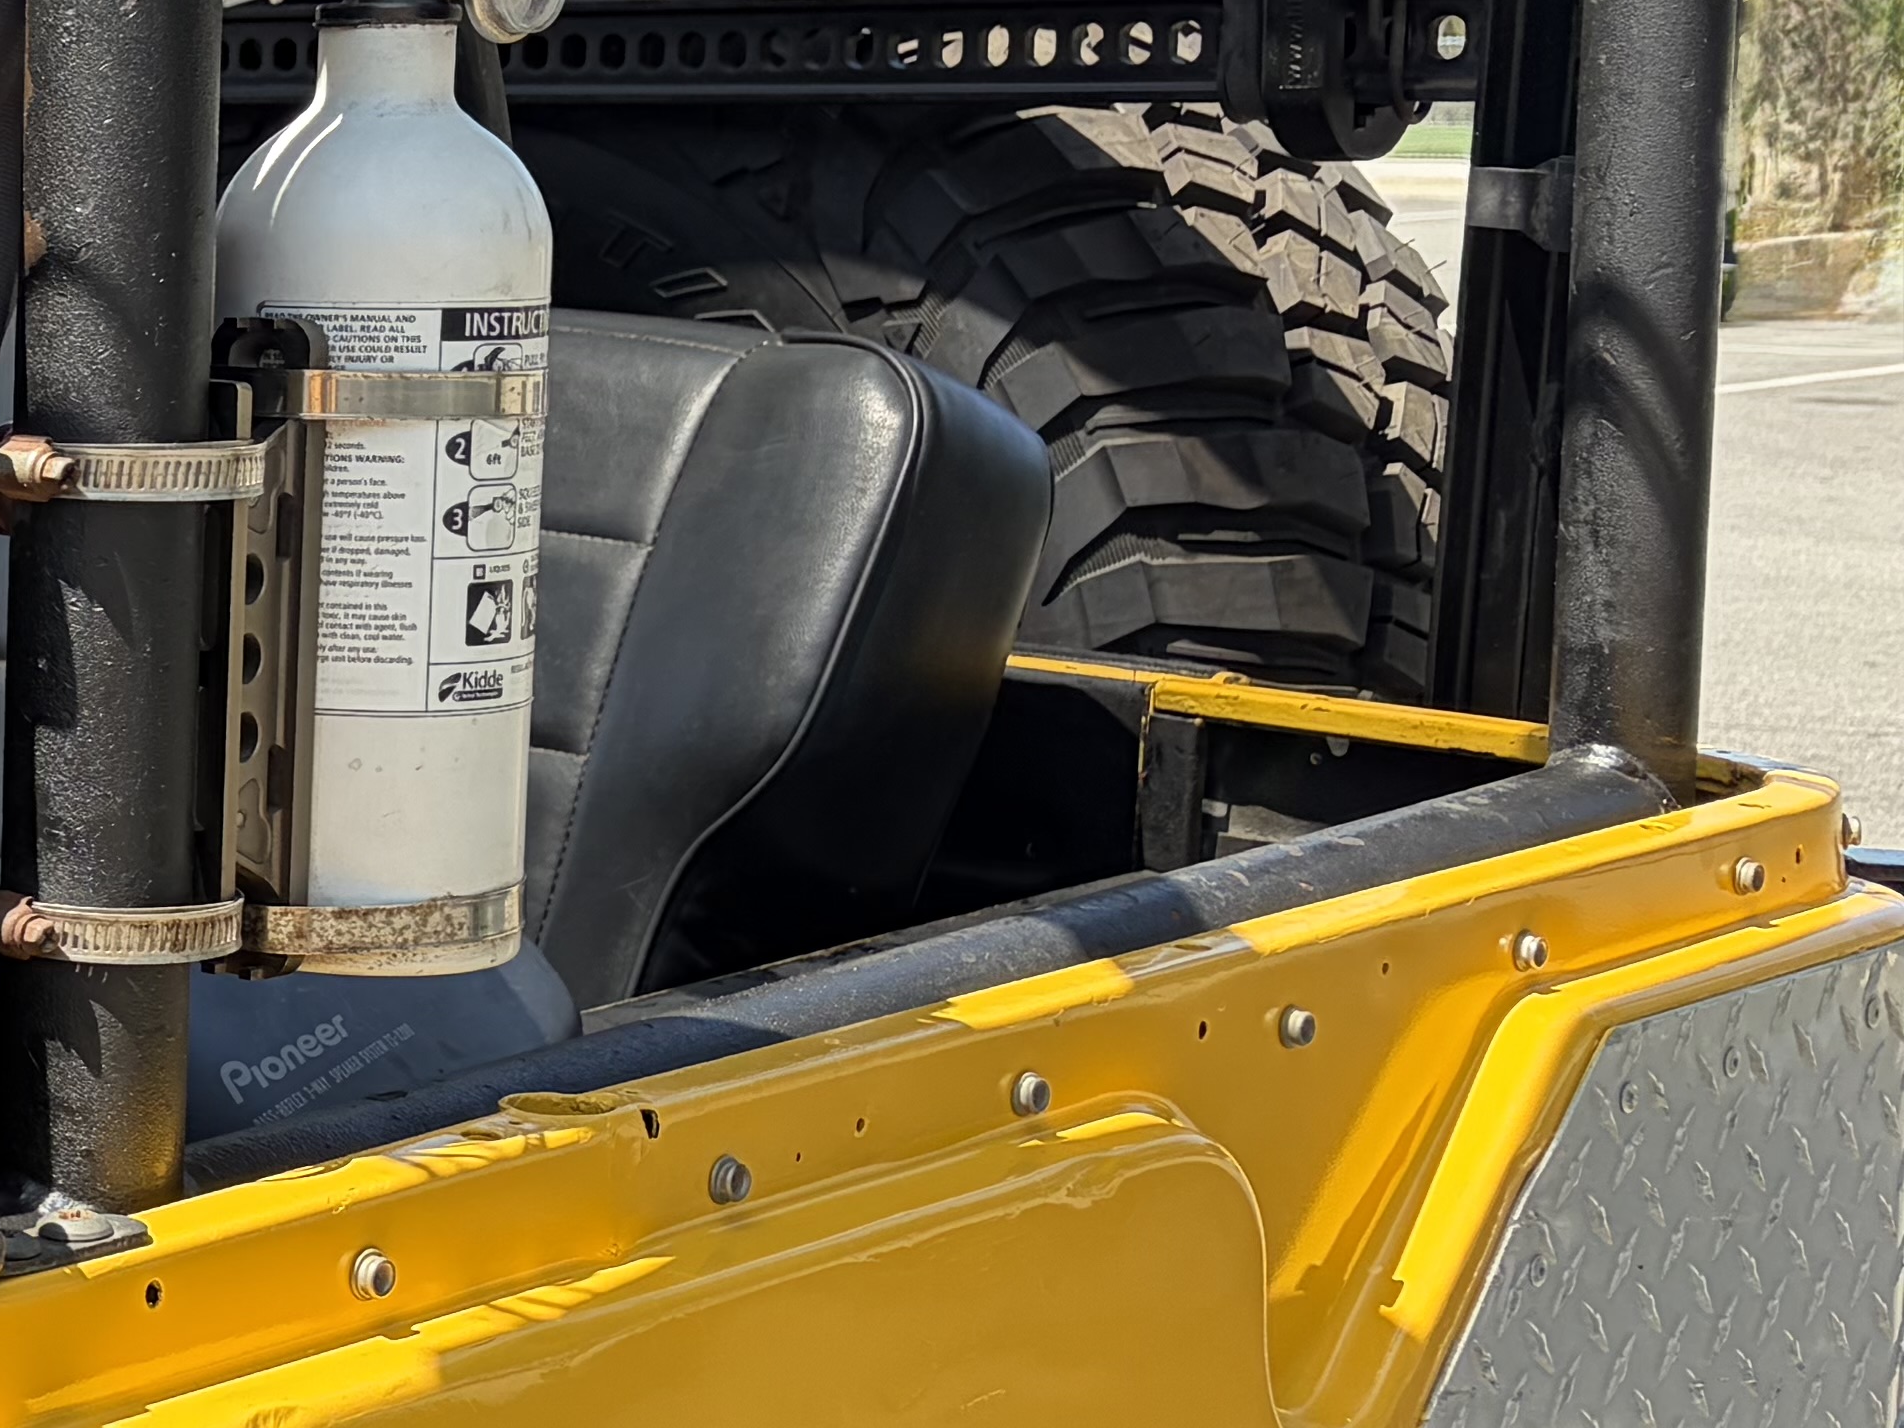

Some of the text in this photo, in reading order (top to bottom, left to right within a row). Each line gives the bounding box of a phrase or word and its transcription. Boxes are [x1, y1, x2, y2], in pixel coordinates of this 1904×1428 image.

[350, 314, 391, 323] MANUAL
[395, 314, 416, 323] AND
[360, 324, 386, 333] READ
[388, 324, 405, 333] ALL
[332, 334, 422, 344] CAUTIONS ON THIS
[338, 345, 427, 354] USE COULD RESULT
[380, 355, 394, 364] OR
[454, 437, 466, 459] 2
[355, 454, 405, 464] WARNING:
[486, 453, 501, 465] 6ft
[452, 508, 463, 530] 3
[462, 669, 503, 689] Kidde
[220, 1014, 349, 1104] Pioneer
[329, 1055, 364, 1083] SPEAKER
[359, 1040, 389, 1064] SYSTEM
